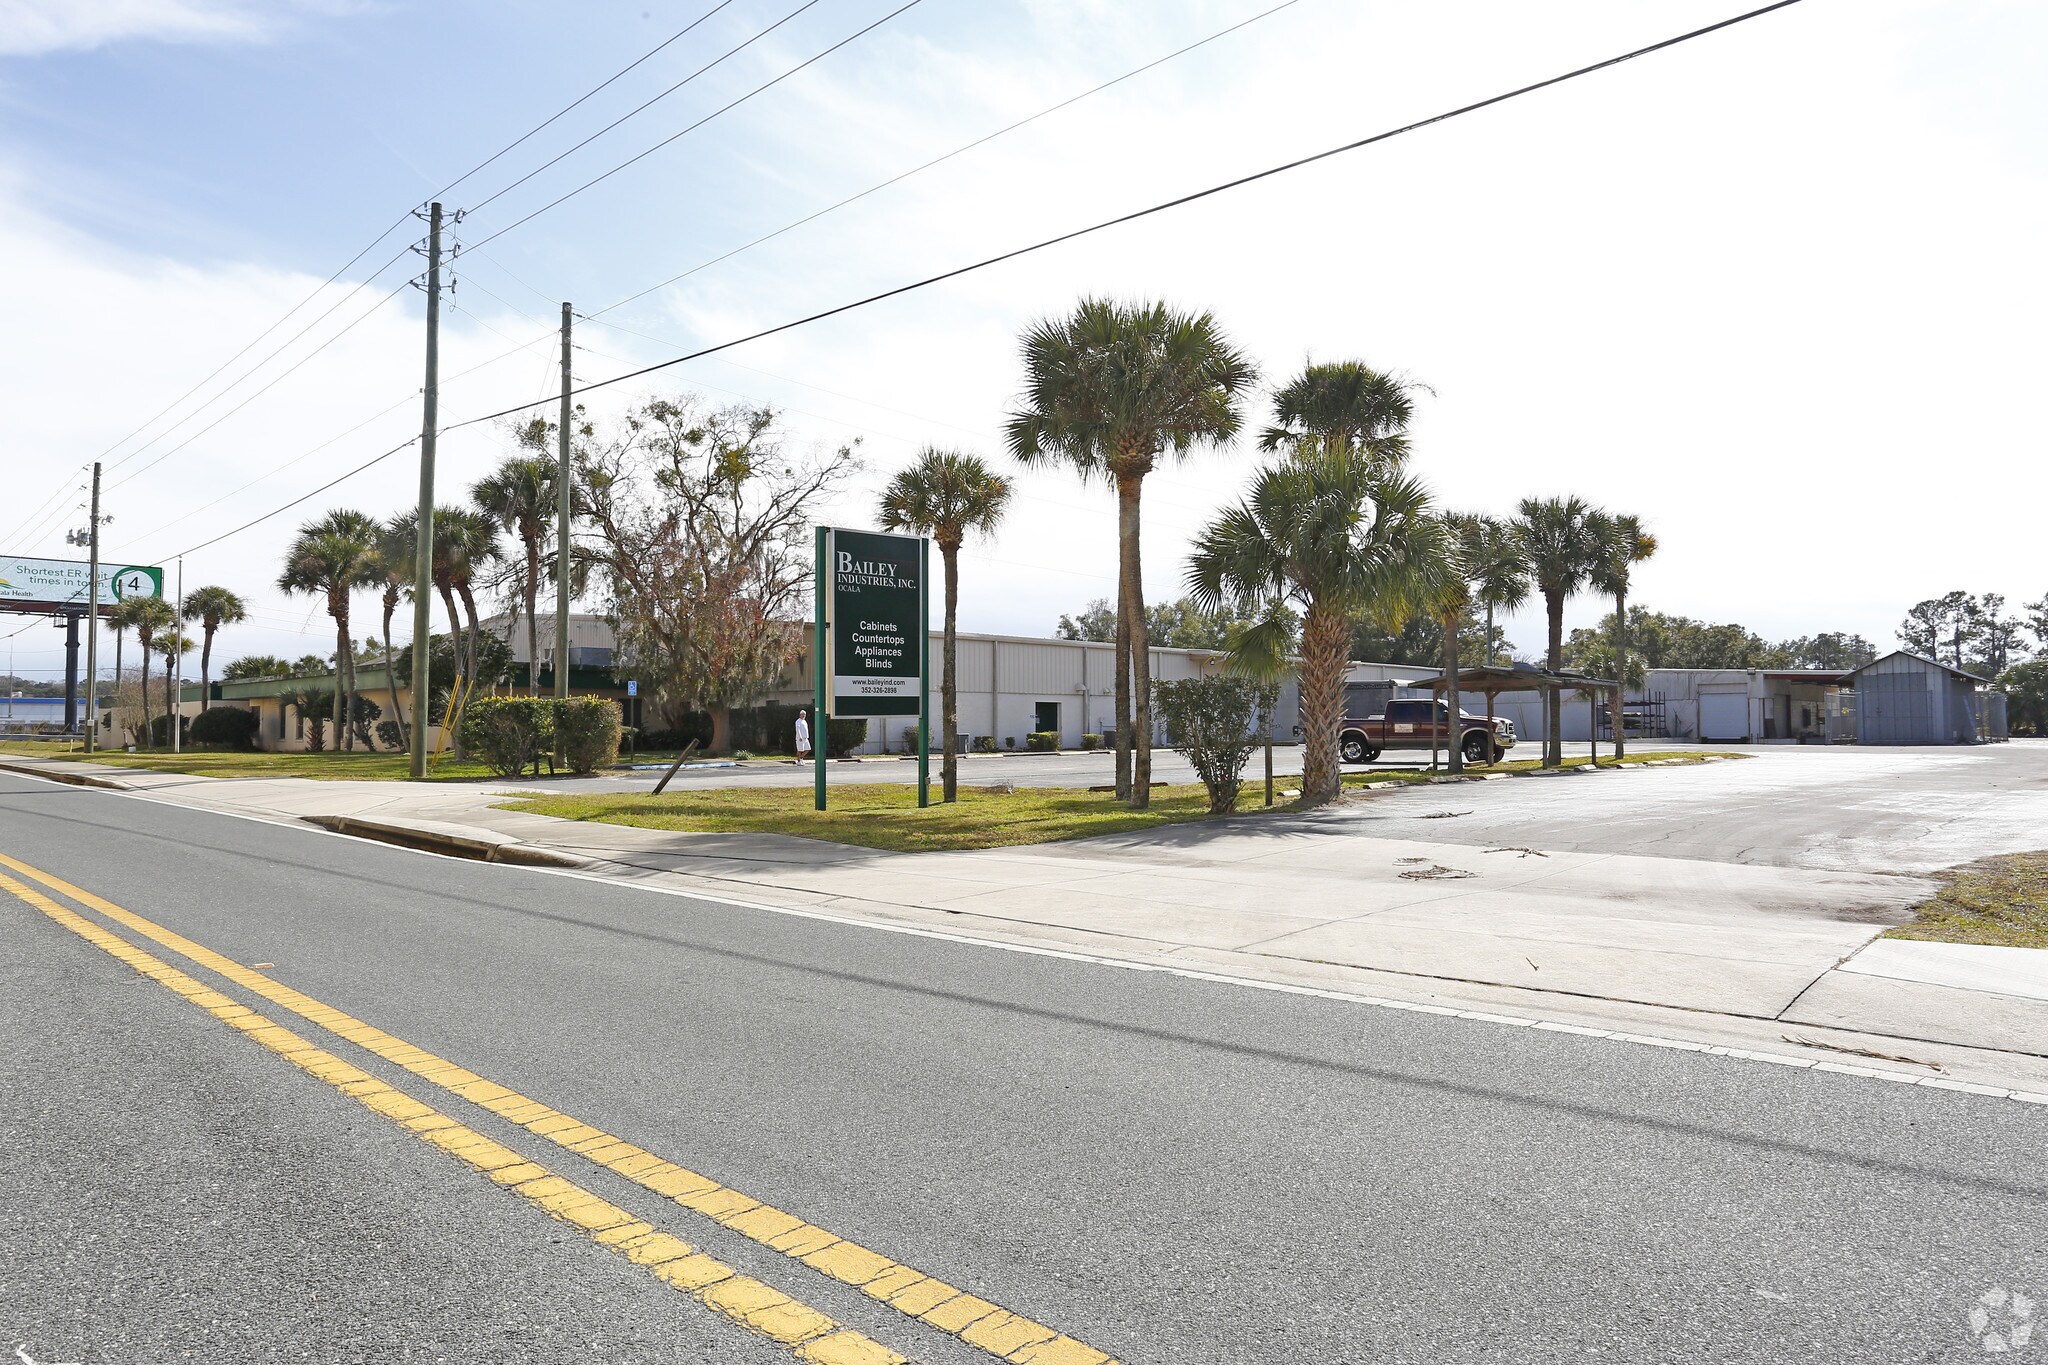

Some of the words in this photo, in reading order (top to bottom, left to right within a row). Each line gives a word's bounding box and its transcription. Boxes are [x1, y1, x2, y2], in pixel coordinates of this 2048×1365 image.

[16, 565, 64, 577] Shortest
[67, 569, 82, 577] ER
[29, 575, 61, 585] times
[64, 578, 74, 586] in
[77, 579, 107, 588] ton.
[128, 576, 140, 591] 4
[837, 573, 896, 589] INDUSTRIES,
[898, 578, 916, 589] INC.
[838, 584, 861, 593] OCALA
[859, 620, 898, 632] Cabinets
[852, 632, 905, 646] Countertops
[854, 645, 902, 657] Appliances
[865, 658, 893, 669] Blinds
[851, 679, 906, 687] www.baileyind.com
